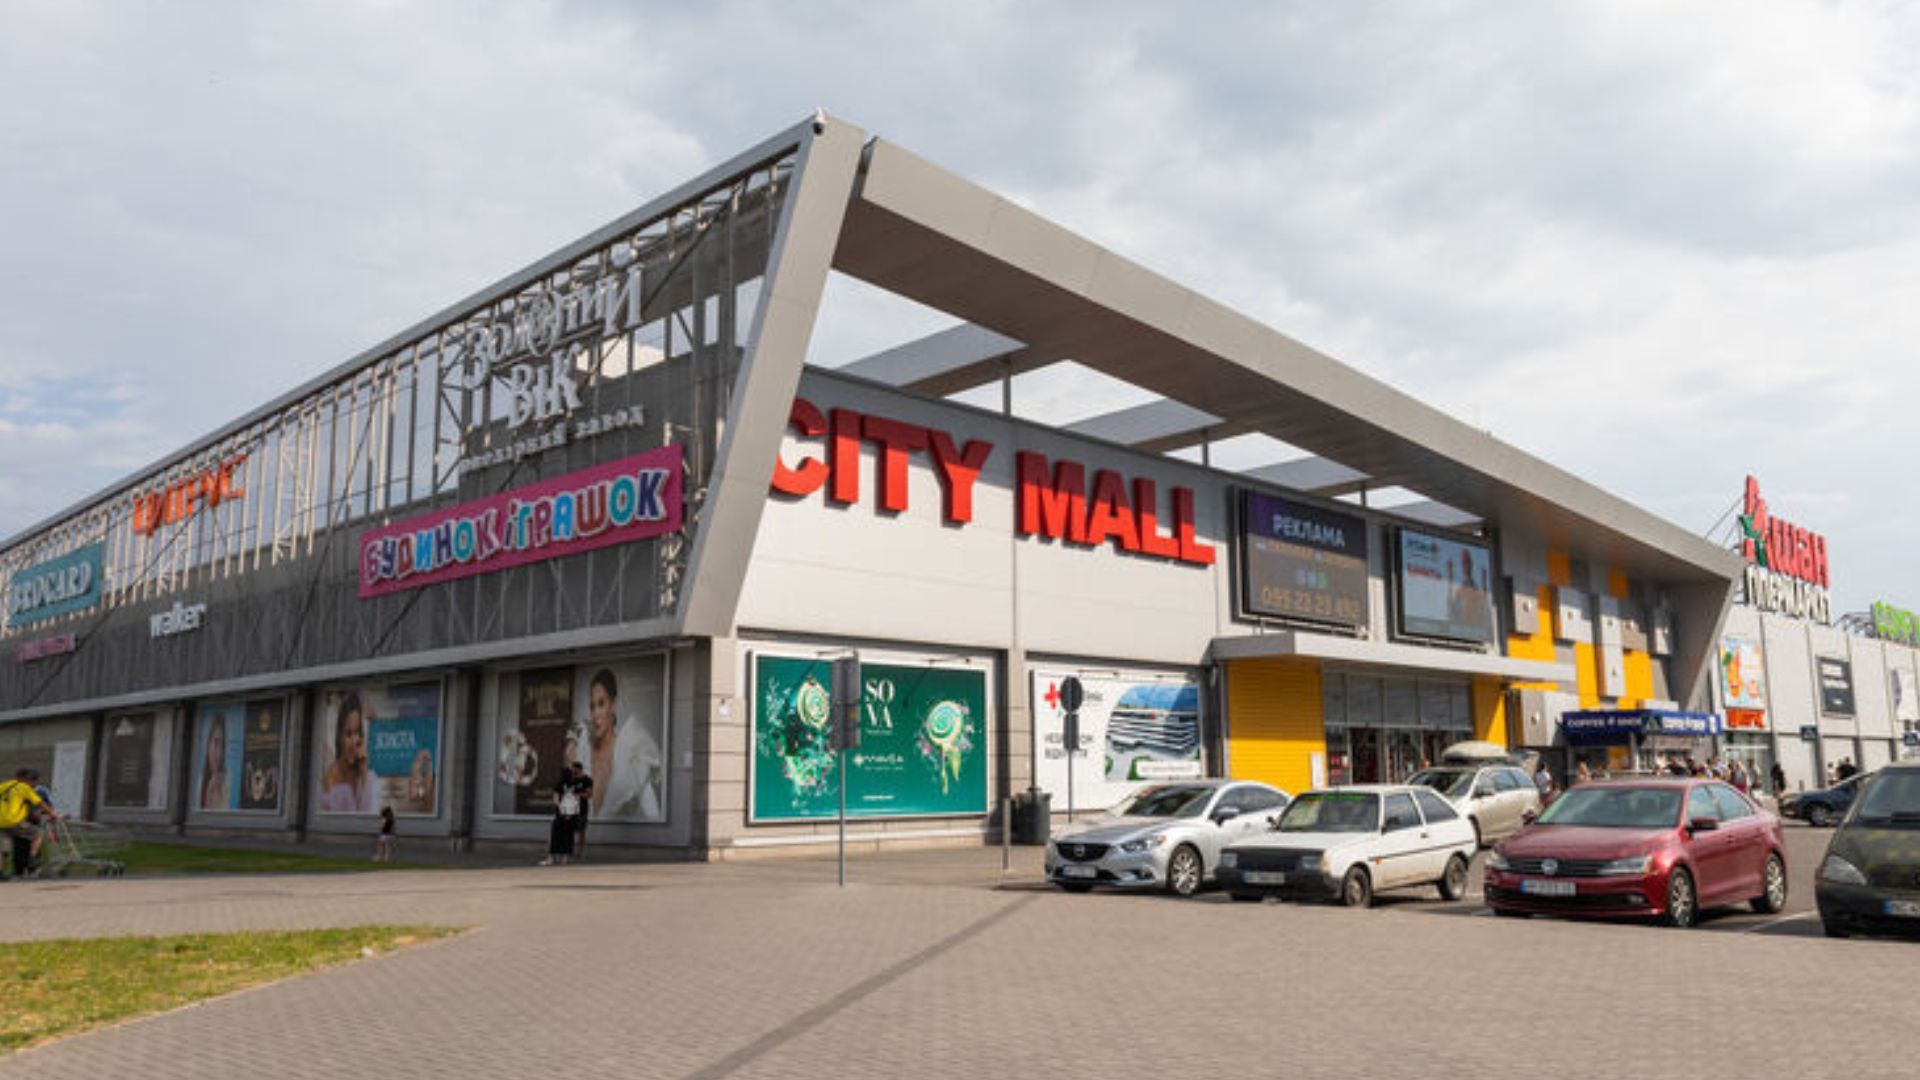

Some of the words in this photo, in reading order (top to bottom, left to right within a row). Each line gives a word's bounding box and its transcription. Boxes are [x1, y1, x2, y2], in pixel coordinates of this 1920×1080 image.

[769, 394, 994, 524] CITY
[1015, 448, 1216, 565] MALL
[363, 508, 500, 586] БУДИНОК
[1272, 512, 1346, 549] РЕКЛАМА
[864, 677, 896, 704] SO
[865, 703, 893, 729] VA
